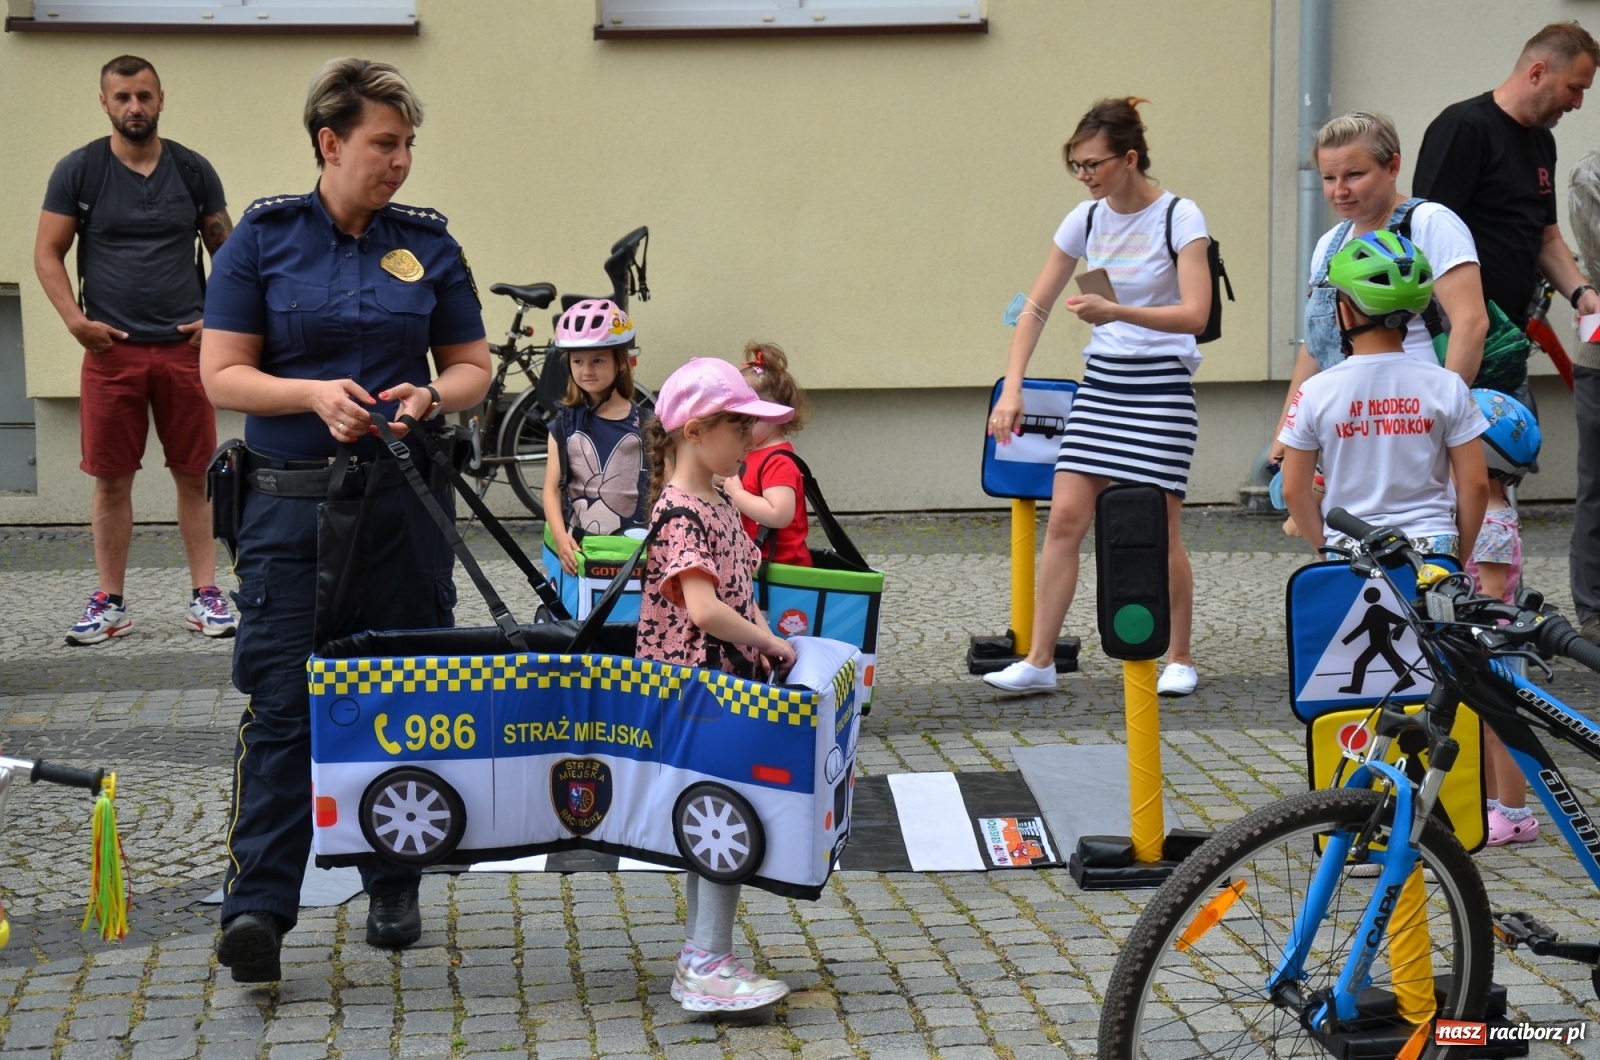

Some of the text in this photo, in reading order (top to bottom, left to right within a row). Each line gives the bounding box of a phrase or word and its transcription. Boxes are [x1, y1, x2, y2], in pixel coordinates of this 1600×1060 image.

[1538, 167, 1551, 187] R
[1350, 398, 1420, 417] AP MŁODEGO
[1373, 415, 1434, 435] TWORKÓW
[404, 713, 476, 751] 986
[503, 715, 654, 749] STRAŻ MIEJSKA
[1516, 688, 1600, 747] a-matri
[559, 770, 605, 783] MIEJSKA
[1538, 768, 1600, 869] auth
[1365, 883, 1403, 949] CAPA
